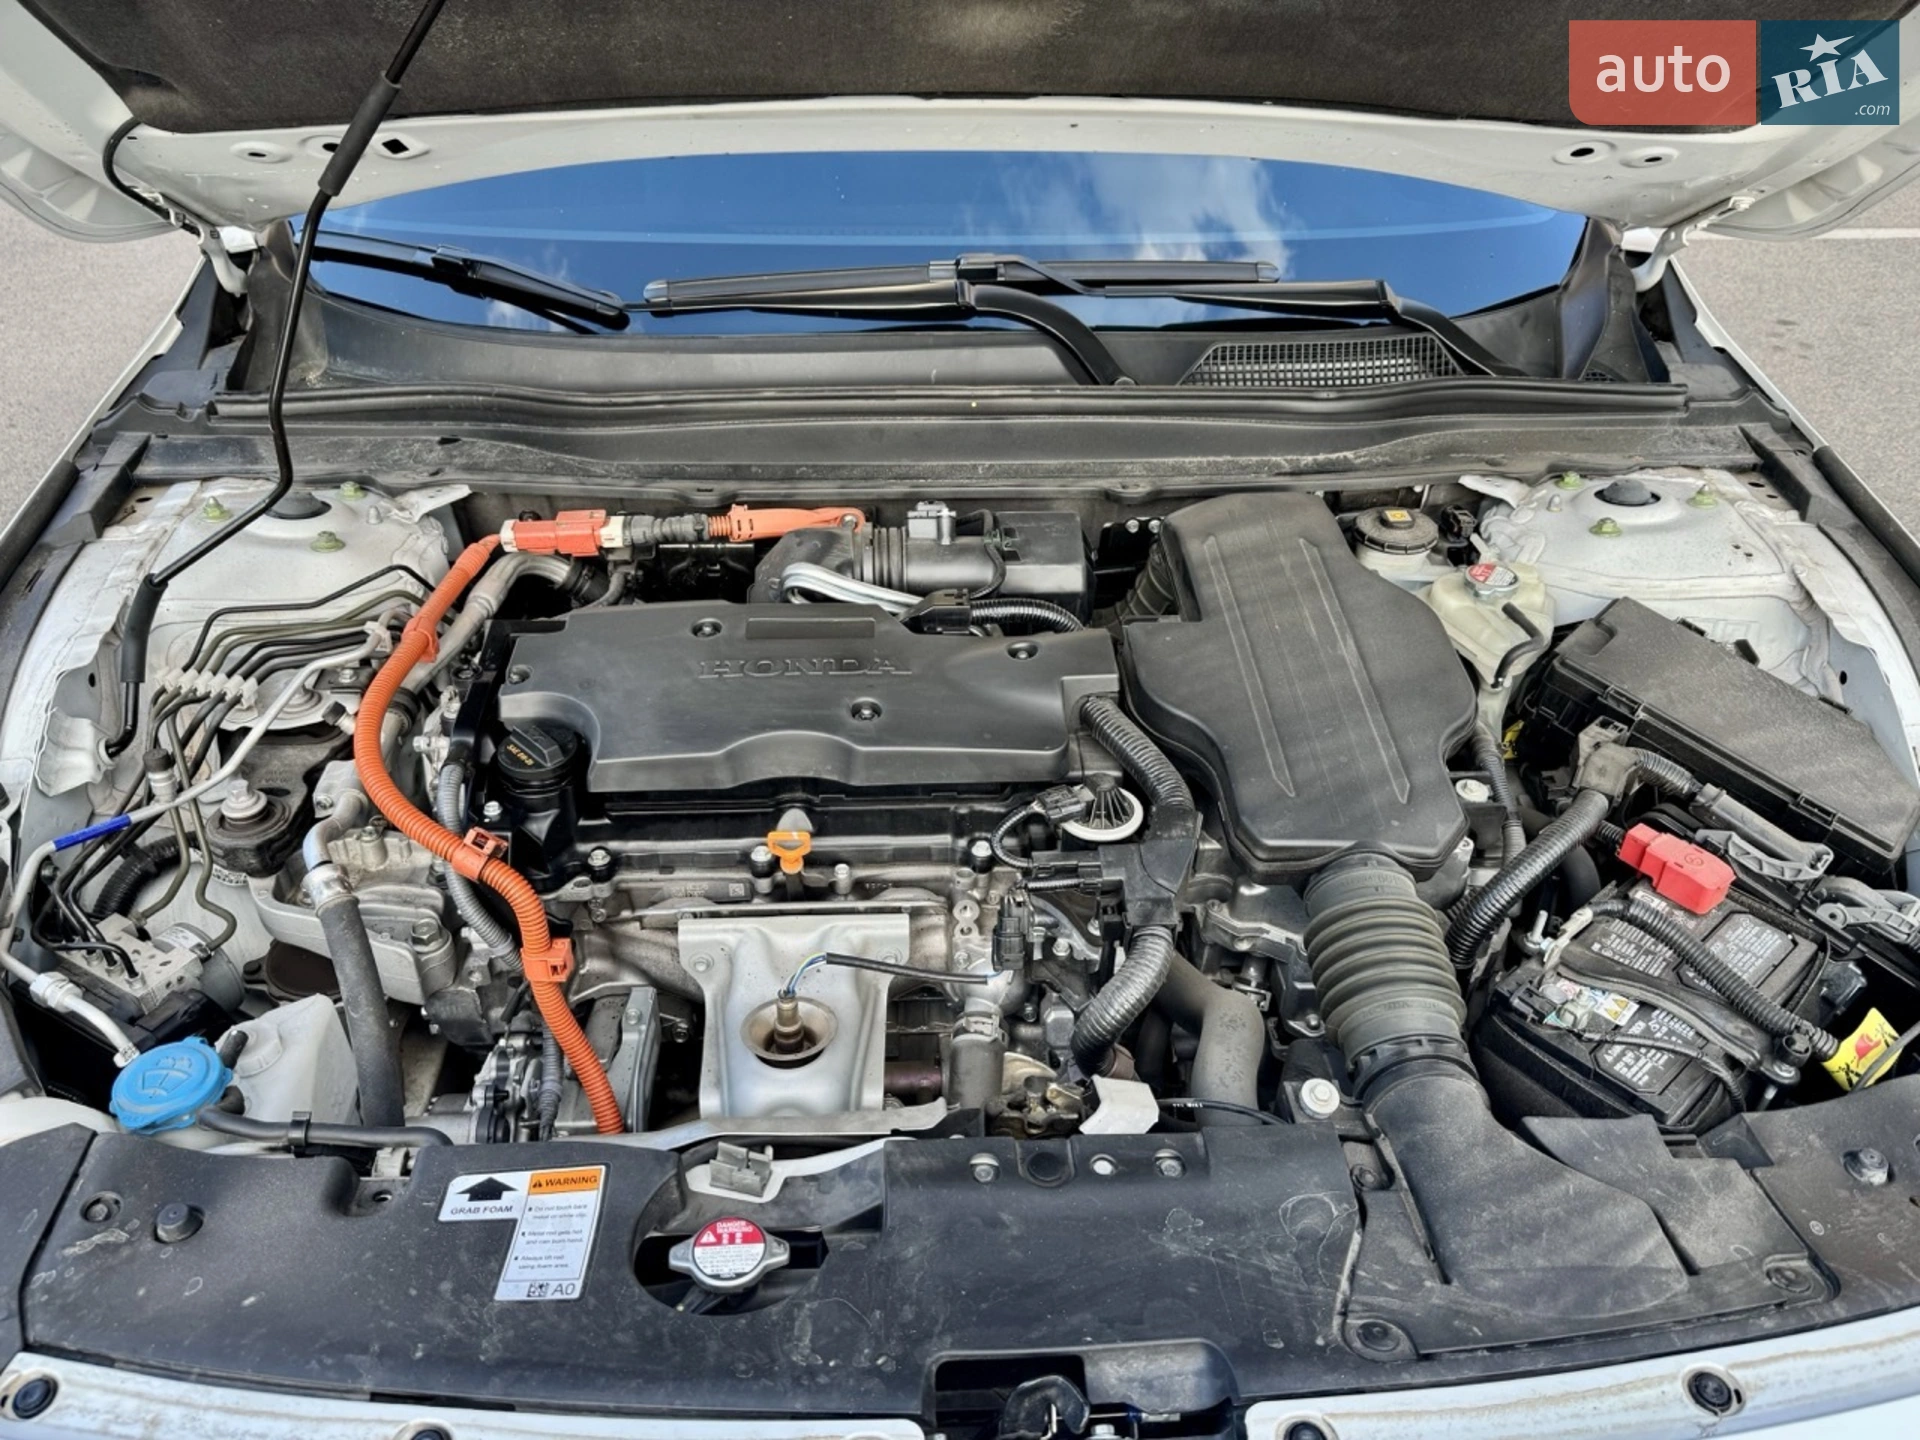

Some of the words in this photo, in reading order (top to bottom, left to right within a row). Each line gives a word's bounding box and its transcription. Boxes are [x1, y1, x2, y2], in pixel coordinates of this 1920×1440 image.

[698, 657, 912, 679] HONDA
[545, 1177, 598, 1188] WARNING
[450, 1206, 480, 1215] GRAB
[482, 1205, 513, 1214] FOAM
